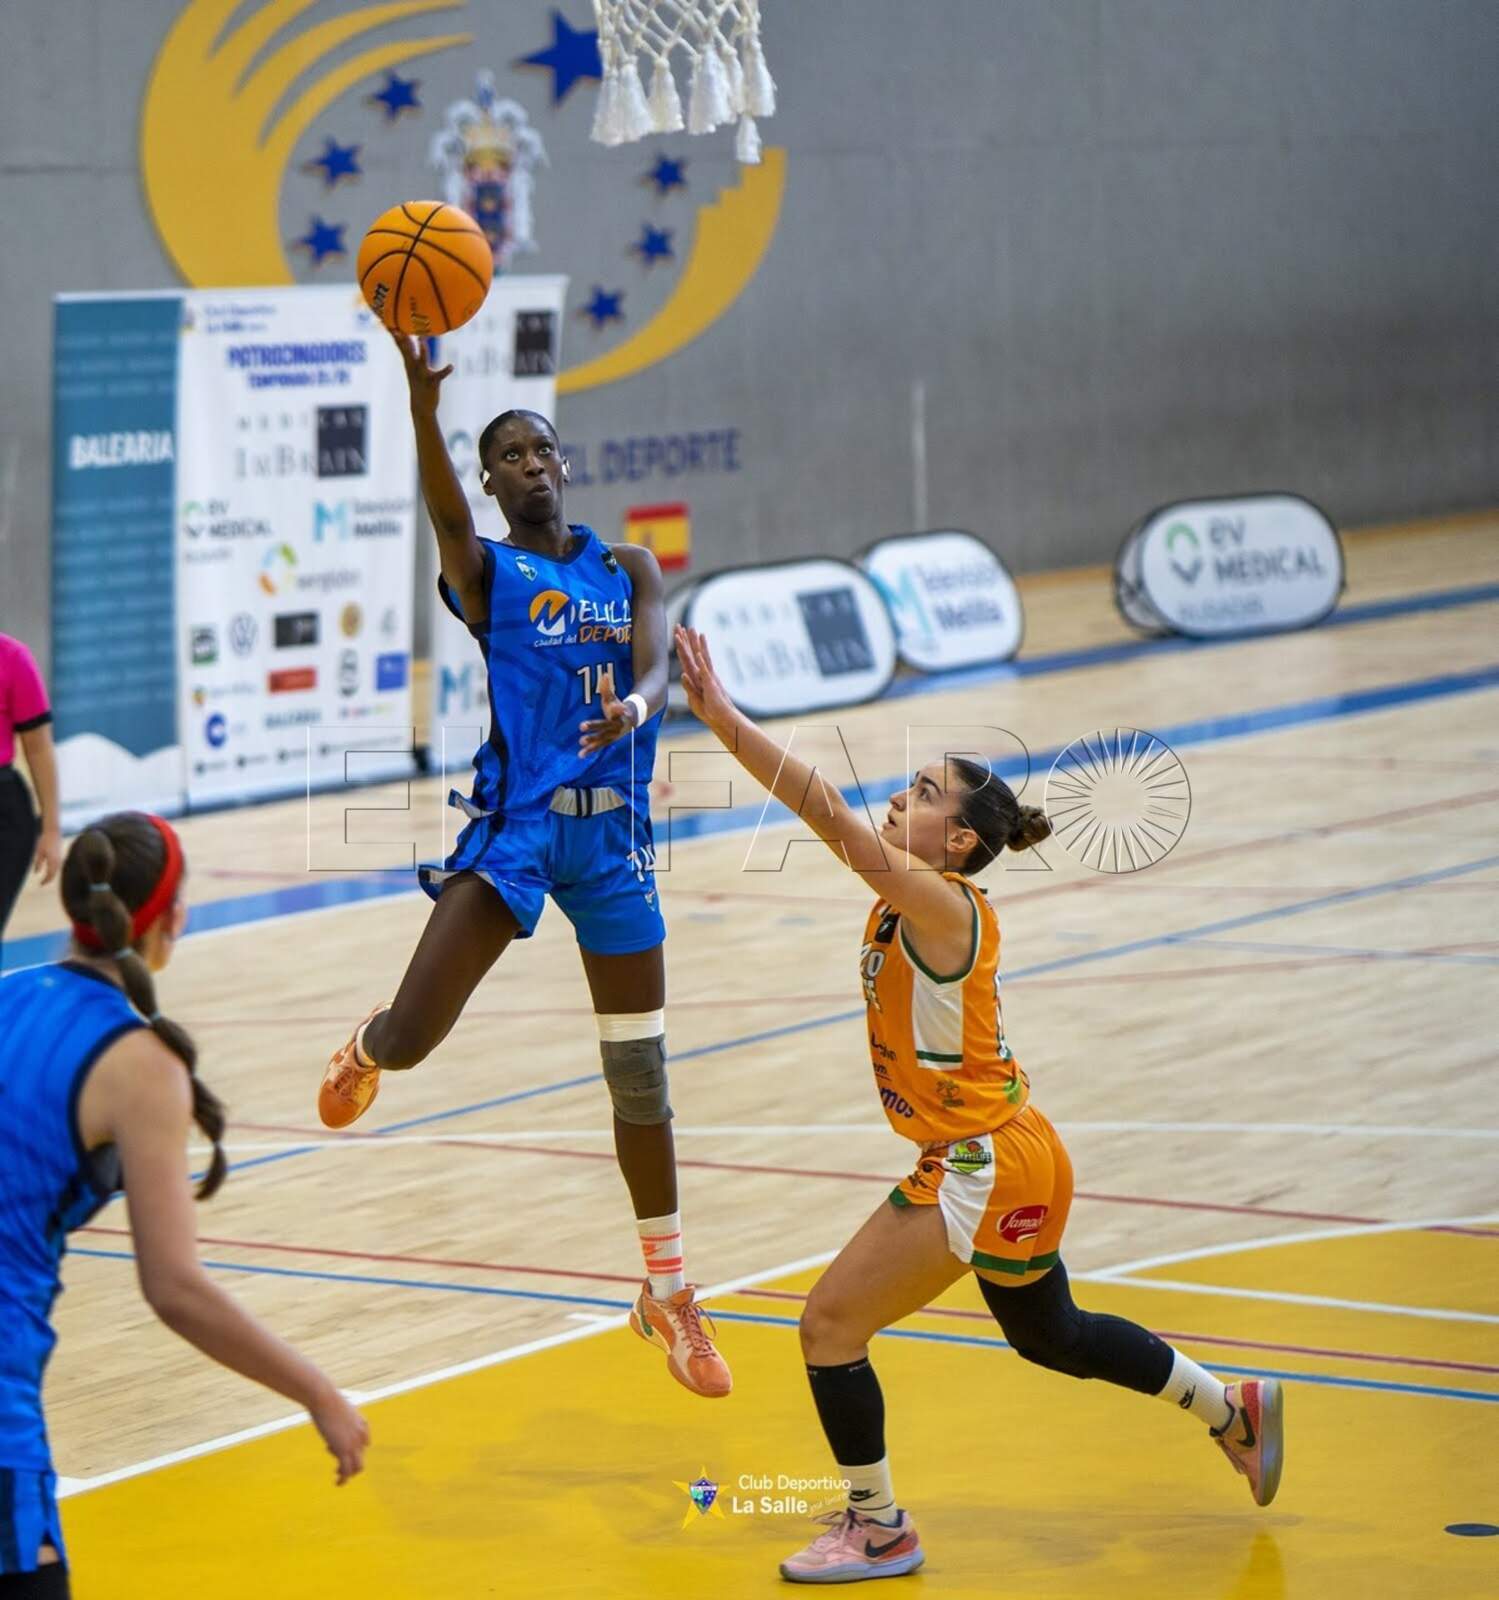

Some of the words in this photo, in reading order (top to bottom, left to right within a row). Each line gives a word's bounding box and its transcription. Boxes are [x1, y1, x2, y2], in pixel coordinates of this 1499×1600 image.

[602, 430, 741, 481] DEPORTE
[579, 623, 634, 644] DEPOR
[576, 663, 616, 705] 14
